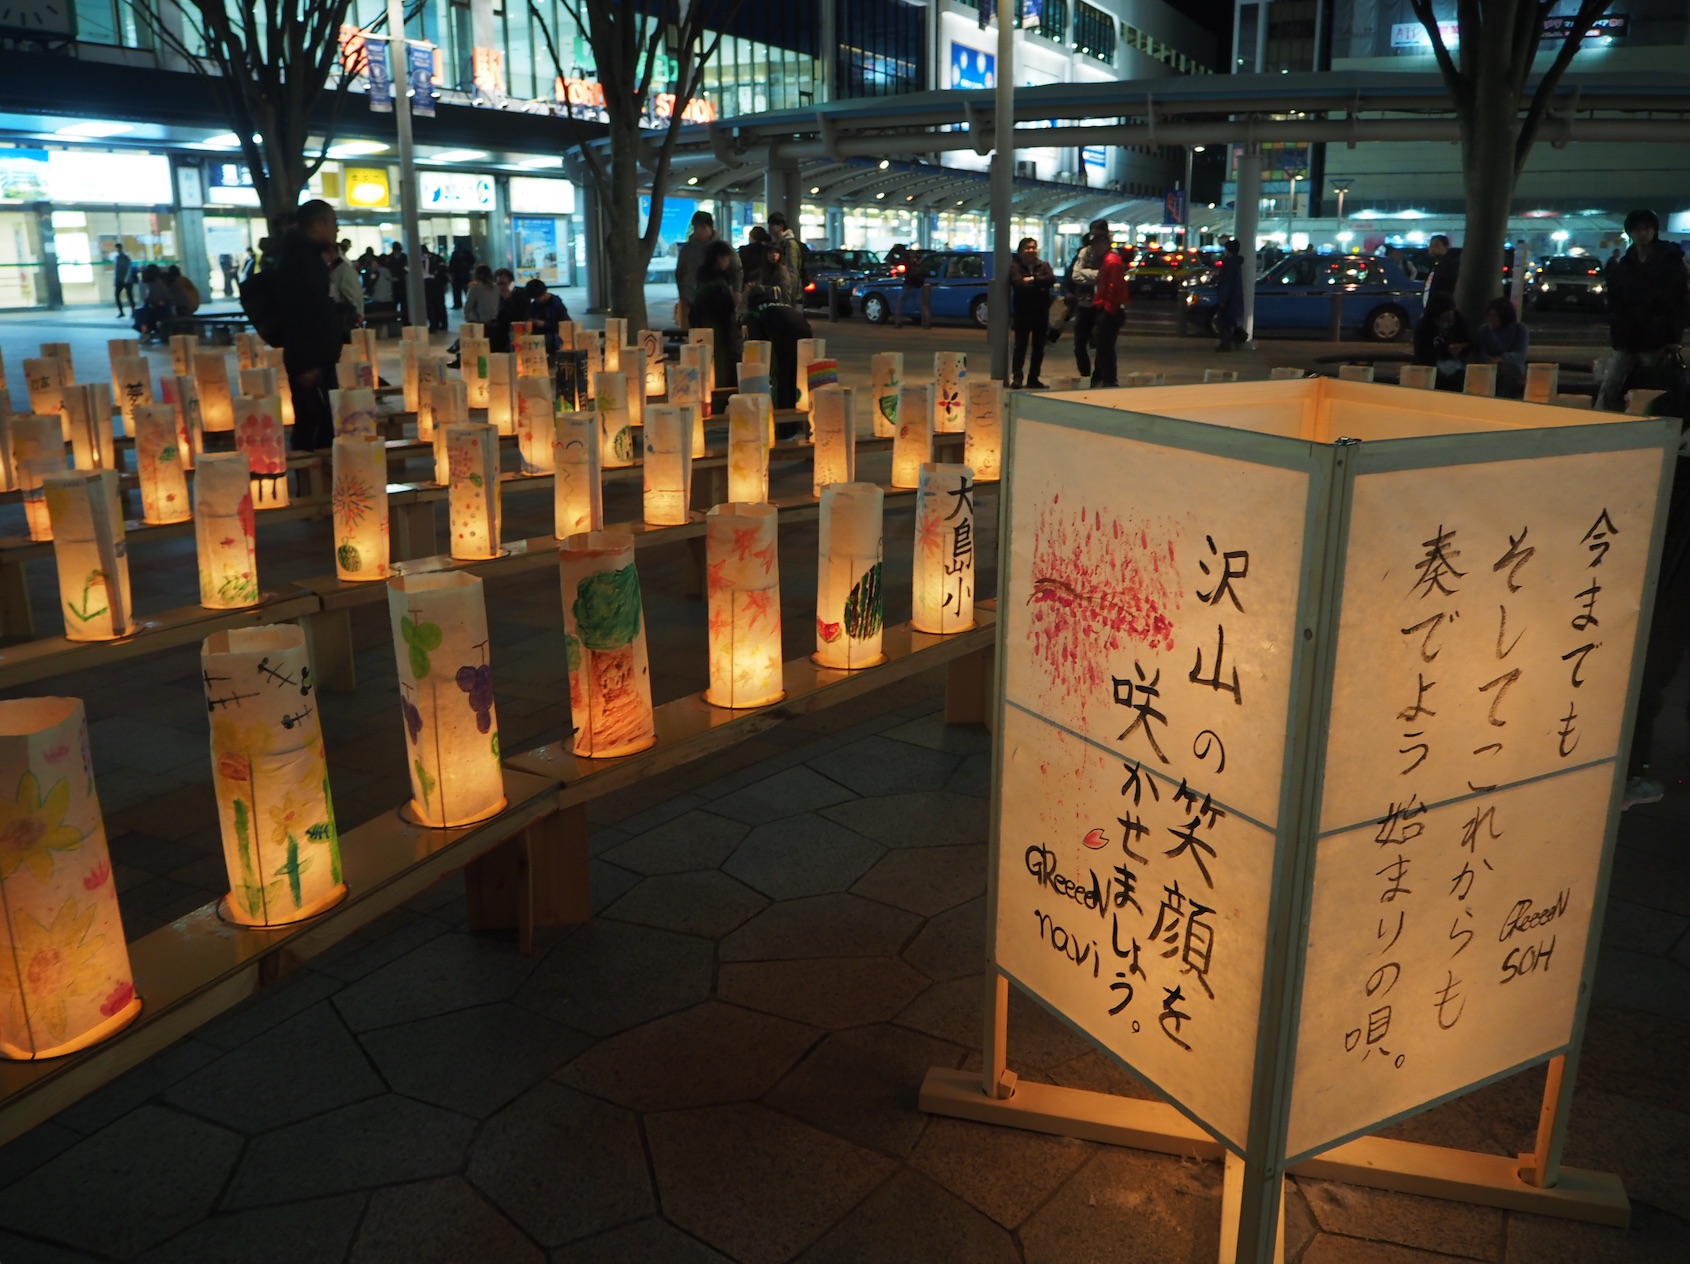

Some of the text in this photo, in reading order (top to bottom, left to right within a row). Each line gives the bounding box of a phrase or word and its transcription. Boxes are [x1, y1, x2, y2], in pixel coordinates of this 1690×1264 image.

[656, 93, 717, 124] STTION
[942, 475, 974, 618] 大島小
[1557, 507, 1619, 758] 今までも
[1108, 661, 1171, 1034] 咲かせましょう。
[1148, 535, 1250, 1052] 沢山の笑顔を
[1433, 526, 1536, 1030] そしてこれからも
[1034, 909, 1100, 979] navi
[1499, 934, 1556, 984] SOH
